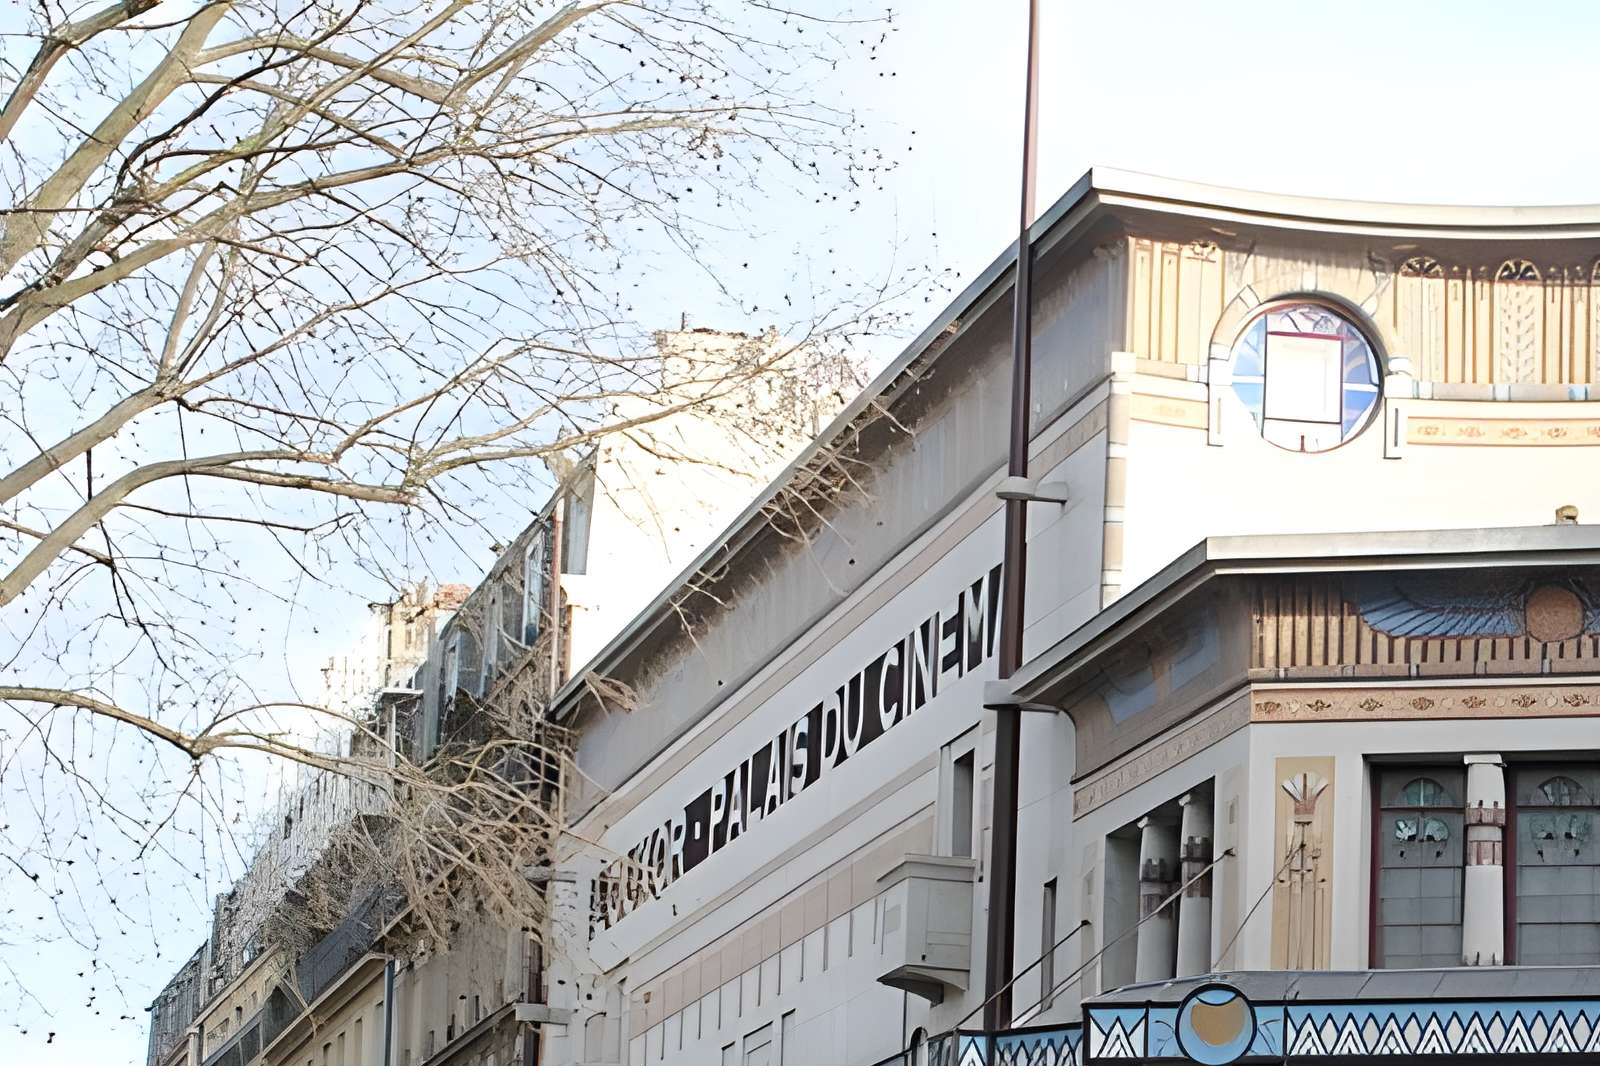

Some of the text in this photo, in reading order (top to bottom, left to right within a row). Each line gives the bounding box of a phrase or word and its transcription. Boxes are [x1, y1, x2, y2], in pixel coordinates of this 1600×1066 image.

[708, 714, 809, 857] PALAIS
[819, 669, 865, 782] DU
[879, 563, 1004, 733] CINEM
